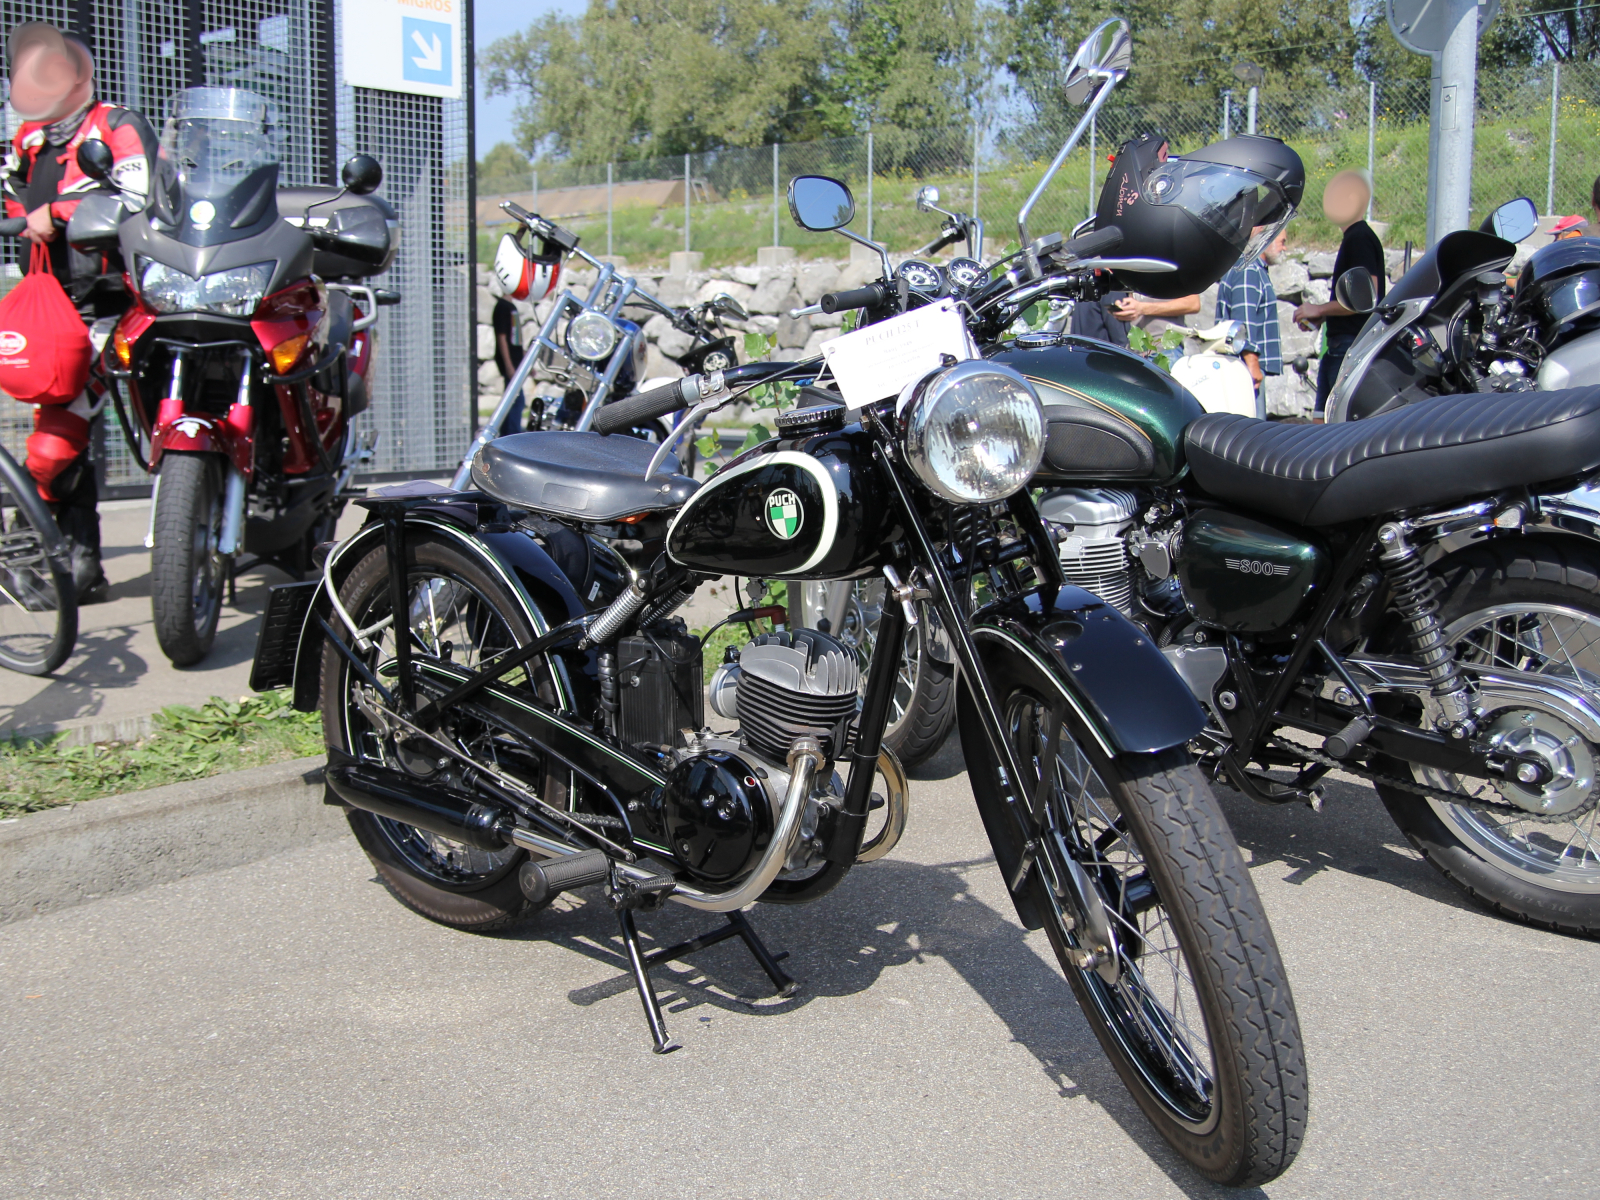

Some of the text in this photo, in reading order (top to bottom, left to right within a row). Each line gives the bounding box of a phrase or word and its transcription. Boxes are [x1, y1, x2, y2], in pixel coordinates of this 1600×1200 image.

[897, 321, 913, 335] 125
[768, 493, 796, 508] PUCH
[1240, 559, 1274, 576] 800
